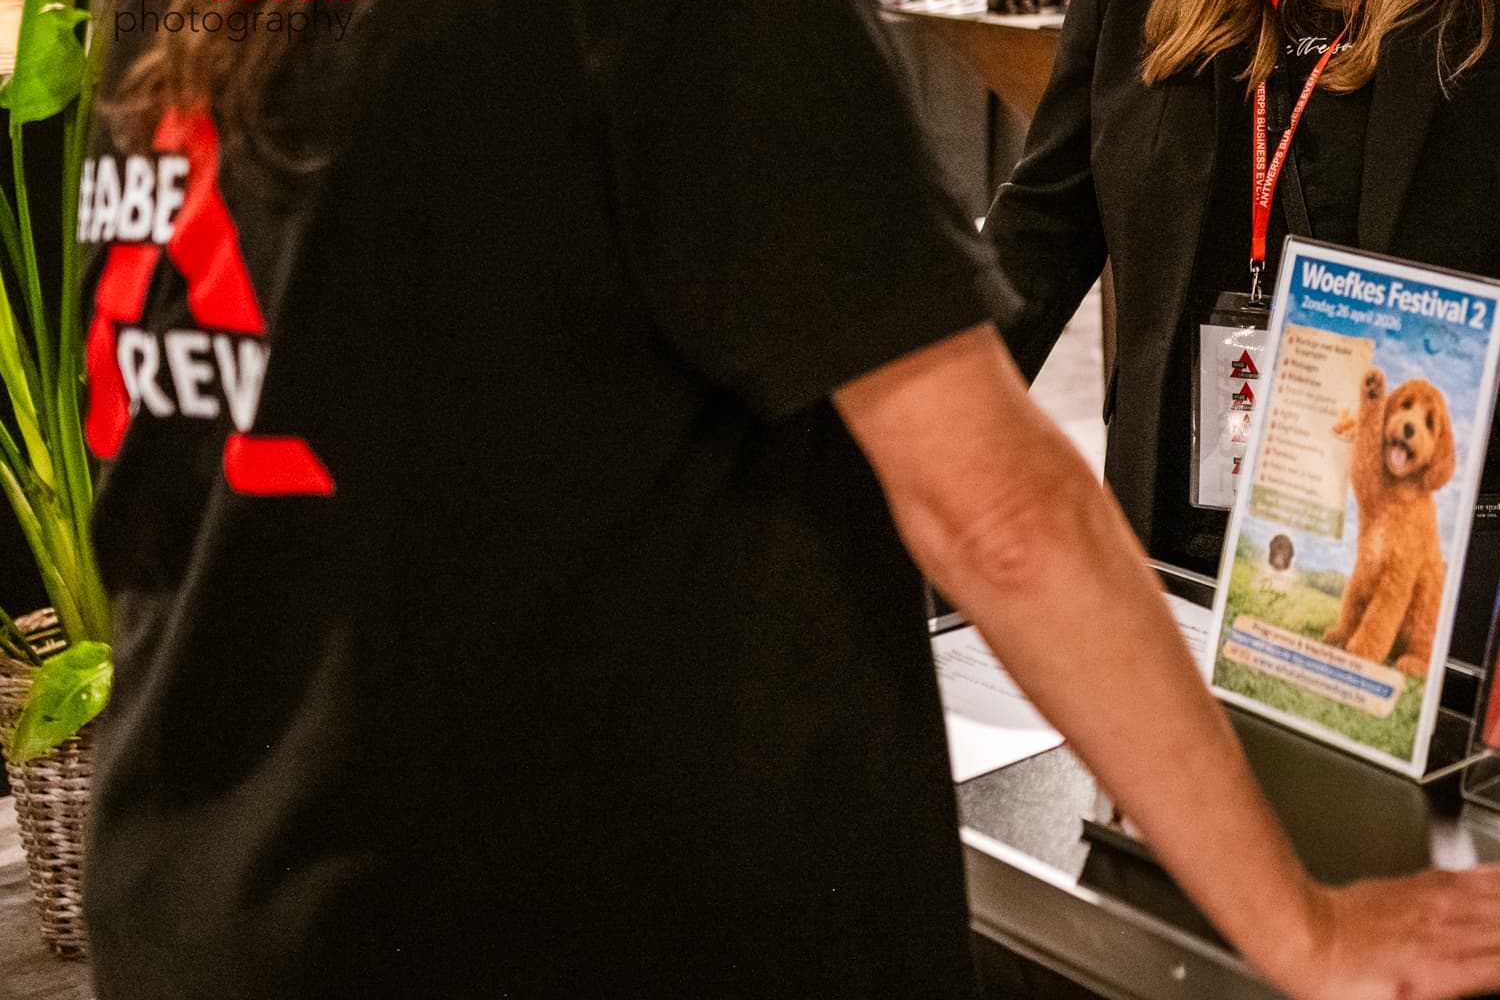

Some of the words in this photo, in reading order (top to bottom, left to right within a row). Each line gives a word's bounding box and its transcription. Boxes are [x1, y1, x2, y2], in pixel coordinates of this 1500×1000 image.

[1256, 118, 1266, 169] BUSINESS
[1259, 151, 1283, 208] ANTWERPS
[1302, 261, 1385, 306] Woefkes
[1388, 281, 1468, 324] Festival
[1469, 301, 1487, 329] 2
